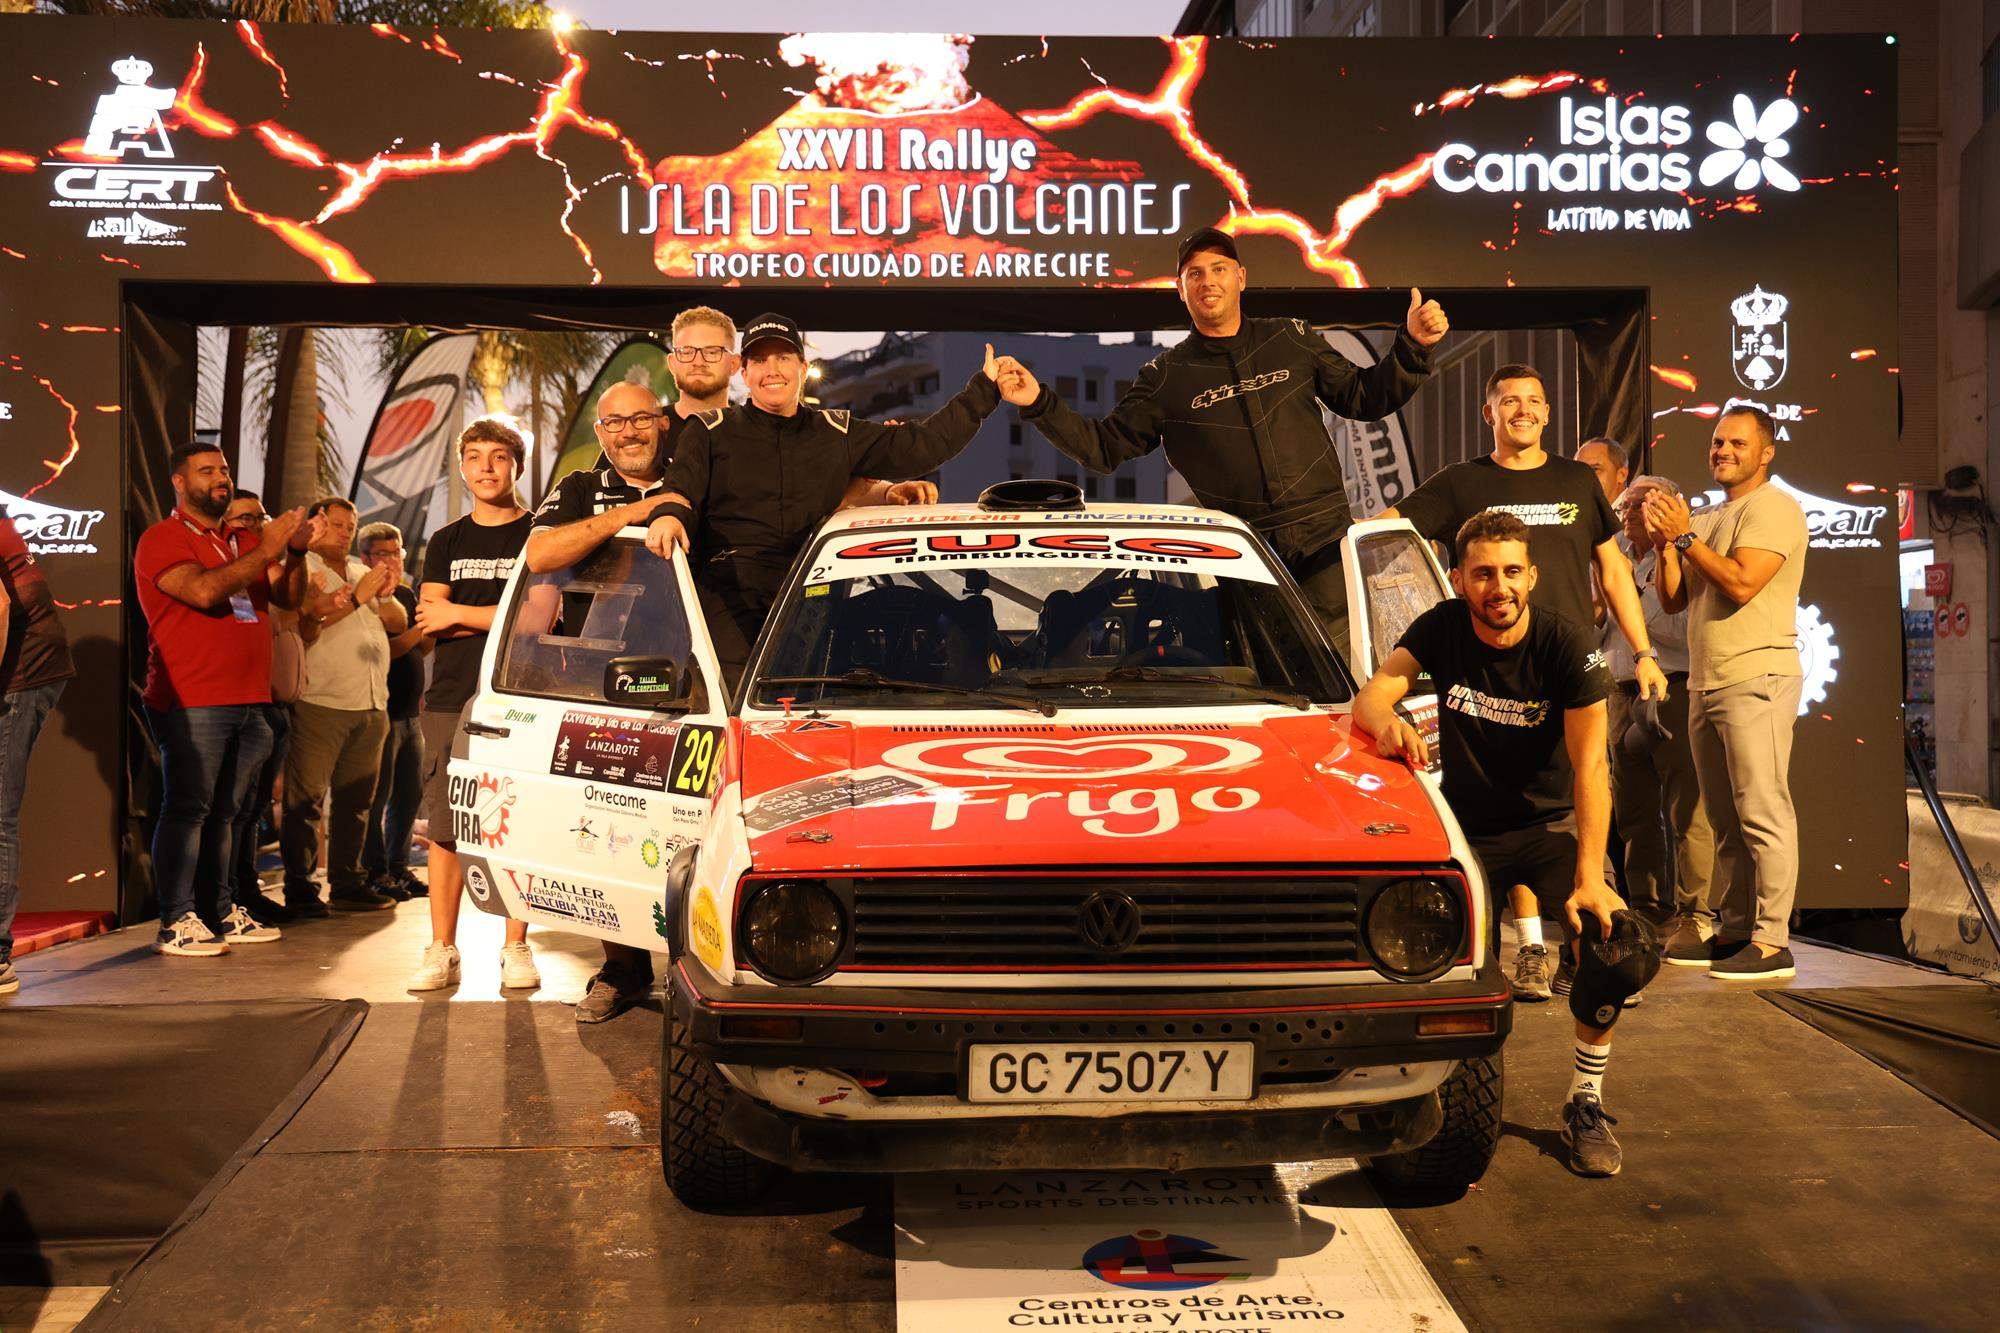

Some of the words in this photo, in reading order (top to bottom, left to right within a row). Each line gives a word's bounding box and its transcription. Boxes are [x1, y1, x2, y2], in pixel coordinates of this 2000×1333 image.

[1560, 96, 1692, 146] Islas
[778, 128, 884, 170] XXVII
[900, 128, 1036, 183] Rallye
[1432, 141, 1692, 193] Canarias
[54, 168, 215, 202] CERT
[621, 183, 731, 235] ISLA
[751, 183, 811, 236] DE
[830, 183, 921, 236] LOS
[938, 183, 1190, 236] VOLCANES
[1547, 206, 1620, 232] LATITUD
[1624, 208, 1647, 231] DE
[1649, 207, 1692, 230] VIDA
[693, 253, 803, 277] TROFEO
[813, 253, 920, 277] CIUDAD
[926, 253, 965, 277] DE
[975, 253, 1110, 277] ARRECIFE
[749, 322, 789, 334] KUMHO
[1776, 403, 1803, 421] DE
[849, 513, 1022, 528] ESCUDERIA
[1043, 511, 1223, 526] LANZAROTE
[836, 533, 1244, 561] CUCO
[895, 549, 1189, 566] HAMBURGUESERIA
[1447, 683, 1525, 714] AUTOSERVICIO
[585, 739, 640, 756] LANZAROTE
[675, 728, 714, 793] 29
[584, 785, 647, 811] Orvecame
[931, 782, 1261, 837] Frigo
[672, 806, 686, 816] Uno
[687, 809, 696, 817] en
[533, 886, 564, 901] CHAPA
[565, 892, 573, 901] Y
[575, 894, 616, 912] PINTURA
[539, 877, 605, 901] TALLER
[519, 891, 578, 913] ARENCIBIA
[583, 906, 620, 922] TEAM
[1933, 944, 1991, 969] Ayuntamiento
[989, 1052, 1049, 1094] GC
[1065, 1050, 1186, 1094] 7507
[1203, 1049, 1230, 1092] Y
[954, 1176, 1285, 1198] LANZAROT
[957, 1199, 1083, 1210] SPORTS
[1018, 1297, 1171, 1312] Centros
[1180, 1295, 1225, 1308] de
[1236, 1293, 1325, 1307] Arte,
[1007, 1311, 1153, 1327] Cultura
[1160, 1311, 1183, 1326] y
[1188, 1308, 1346, 1323] Turismo
